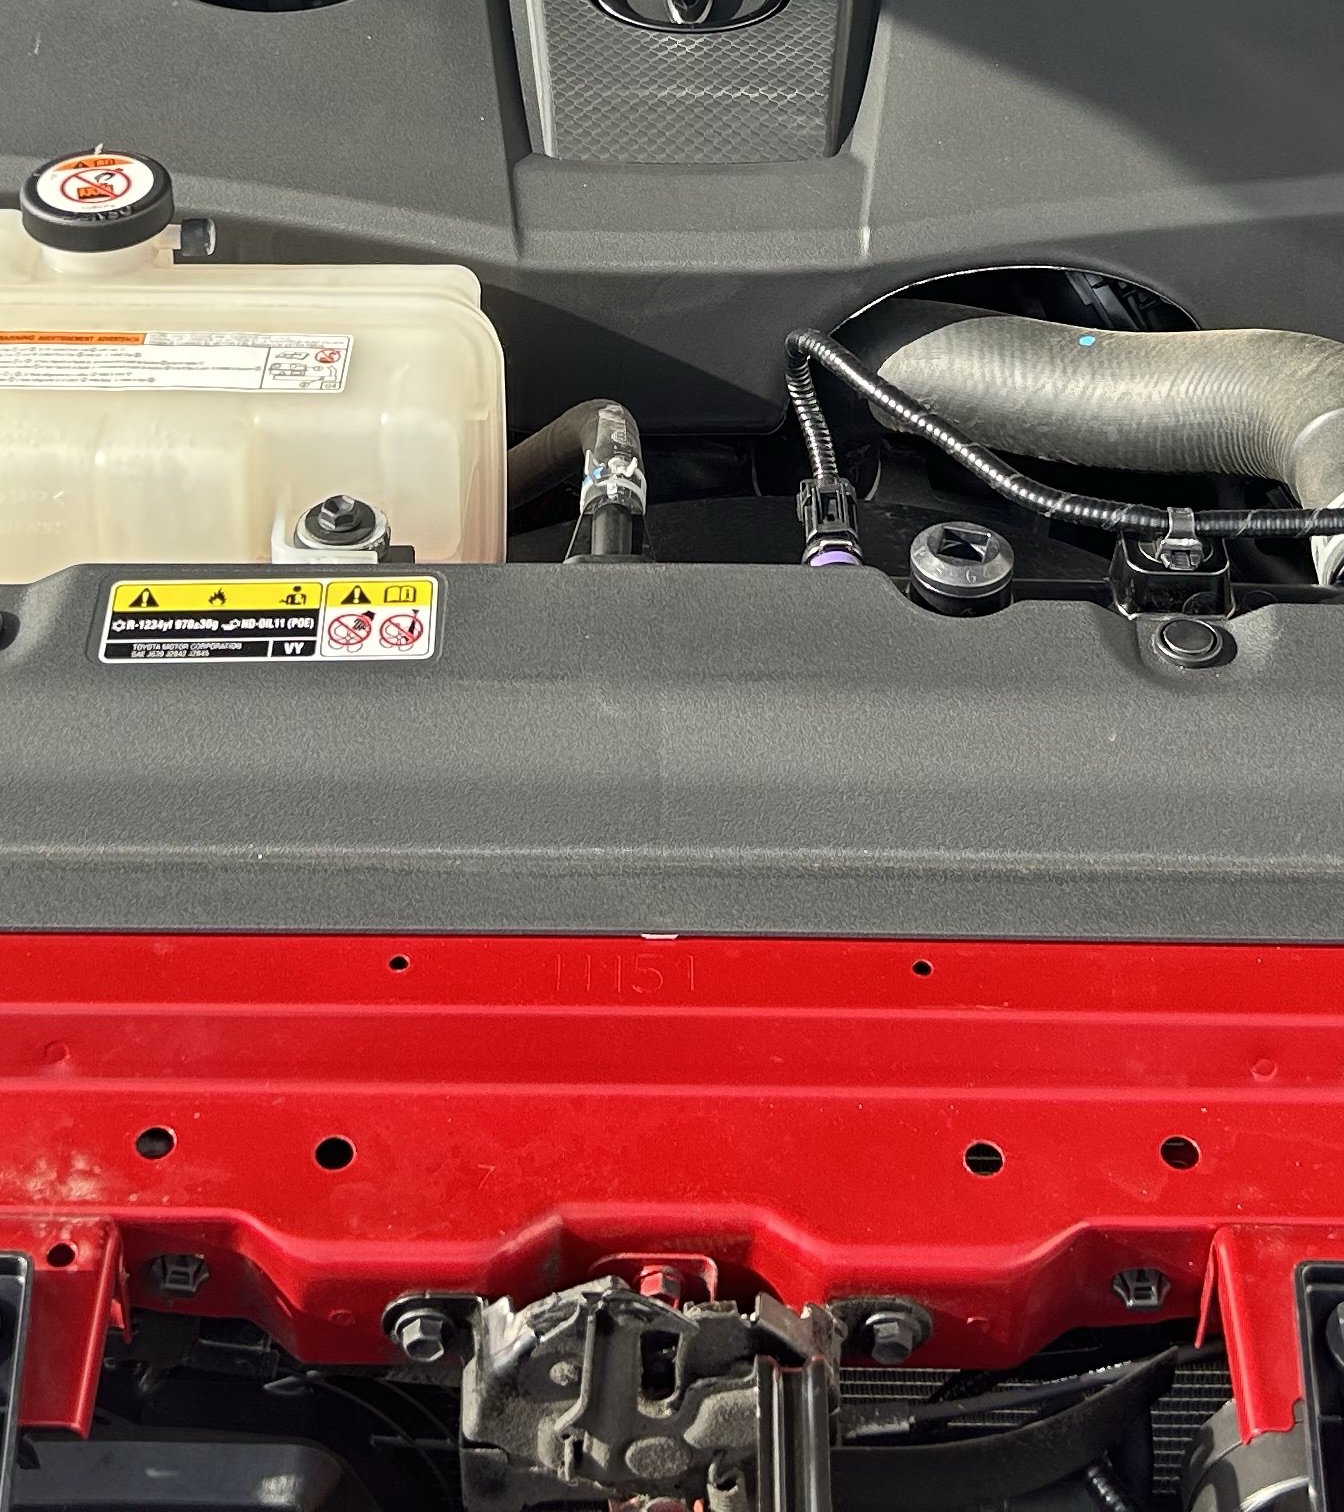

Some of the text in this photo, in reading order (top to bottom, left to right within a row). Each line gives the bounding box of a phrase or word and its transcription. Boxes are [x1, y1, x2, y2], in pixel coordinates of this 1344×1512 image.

[126, 618, 174, 632] R-1234yf
[240, 618, 285, 630] ND-OIL11
[286, 618, 315, 630] (POE)
[132, 643, 160, 651] TOYOTA
[284, 642, 304, 655] VY
